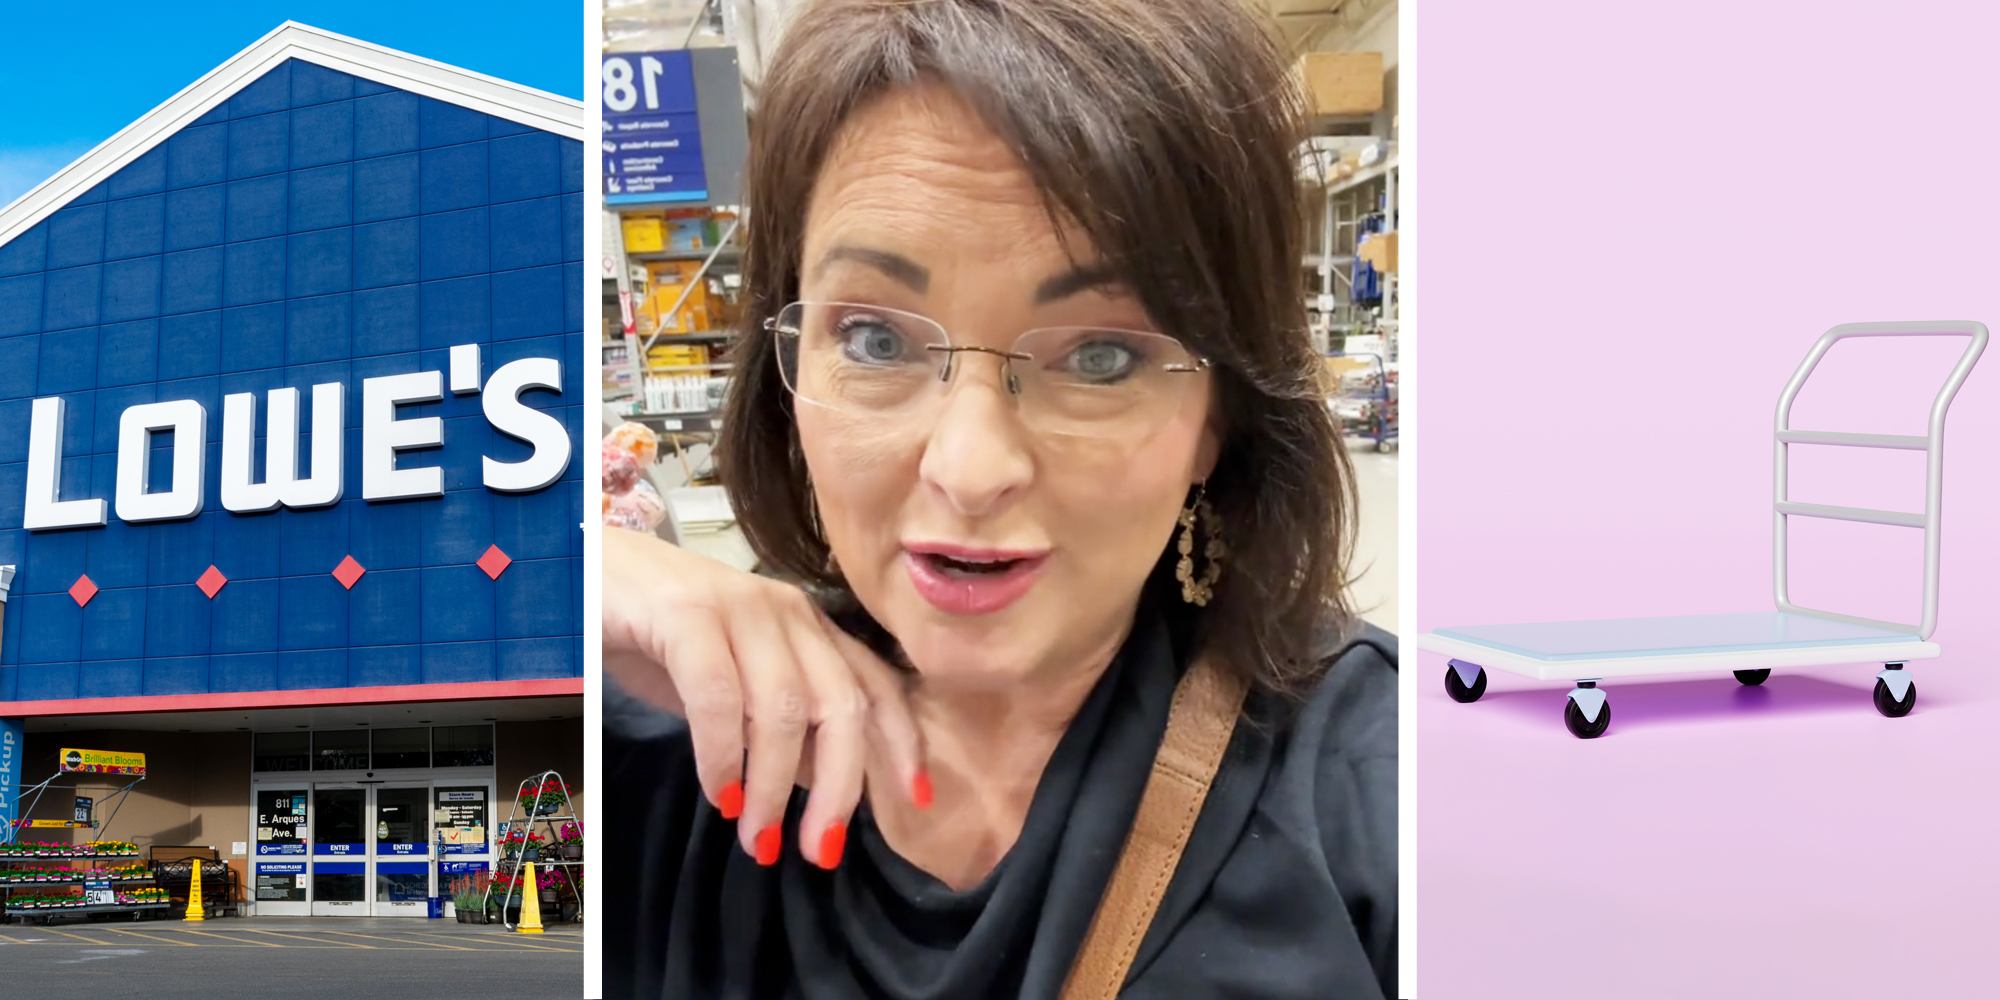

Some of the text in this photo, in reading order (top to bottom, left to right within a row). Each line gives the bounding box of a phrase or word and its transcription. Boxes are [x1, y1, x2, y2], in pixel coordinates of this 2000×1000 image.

[24, 343, 571, 530] LOWE'S
[84, 753, 143, 766] Brilliant Blooms
[0, 731, 15, 808] Pickup
[276, 798, 290, 809] 811
[260, 814, 305, 825] E. Arques
[272, 828, 293, 838] Ave.
